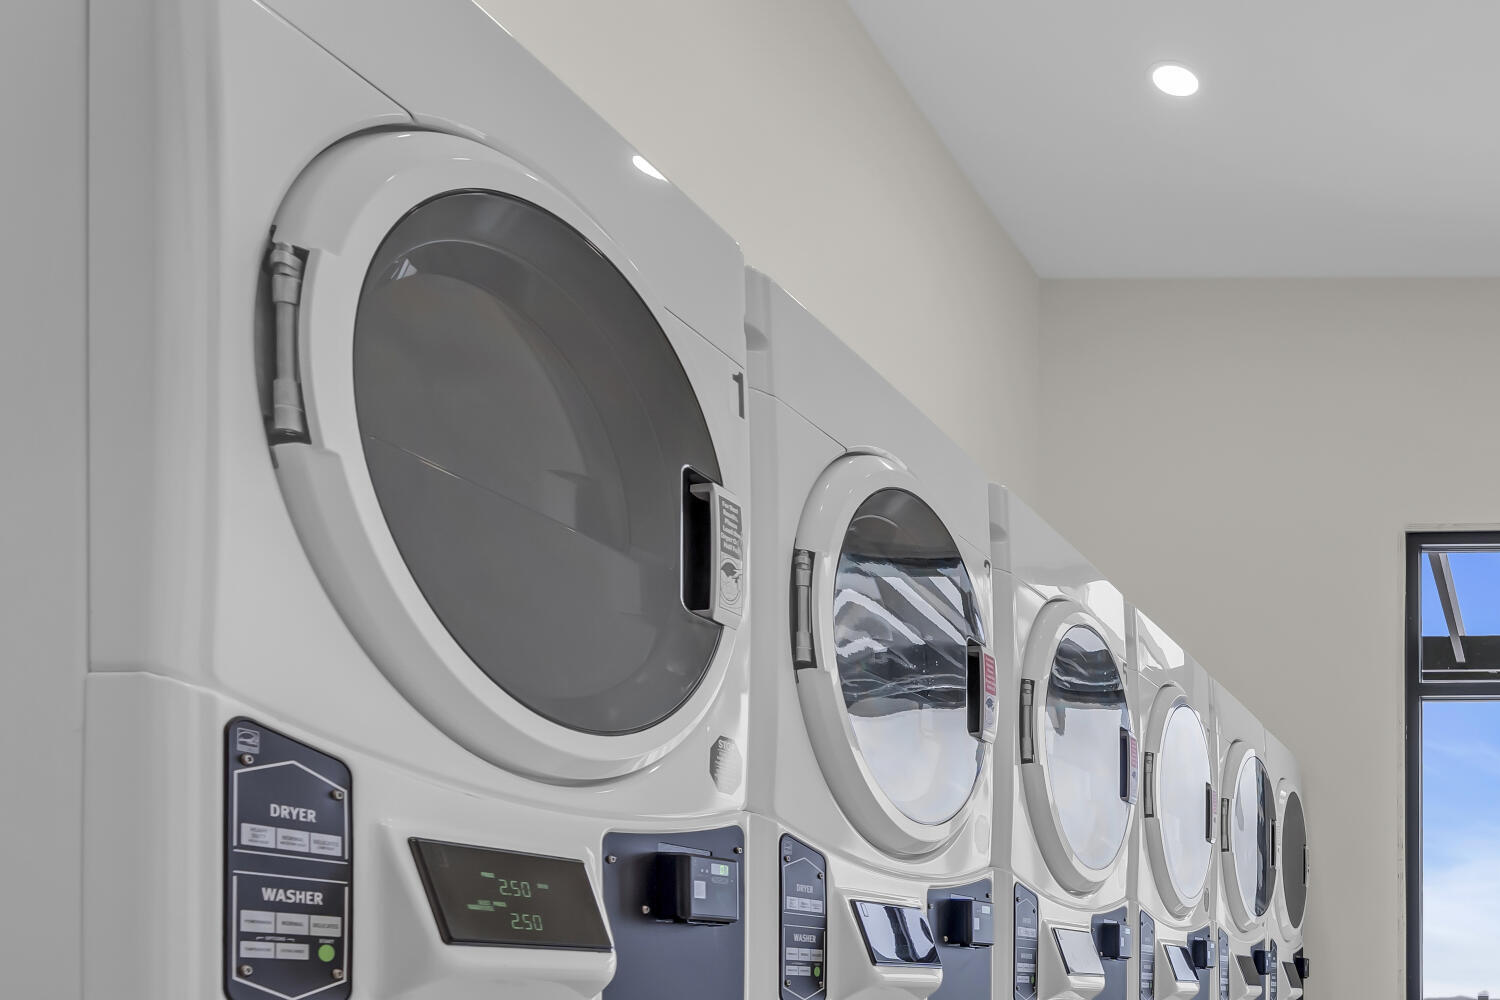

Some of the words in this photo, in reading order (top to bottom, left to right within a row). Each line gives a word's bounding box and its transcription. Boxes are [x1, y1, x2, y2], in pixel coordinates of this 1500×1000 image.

[732, 371, 745, 420] 1
[269, 803, 317, 823] DRYER
[261, 887, 324, 906] WASHER
[793, 933, 817, 943] WASHER
